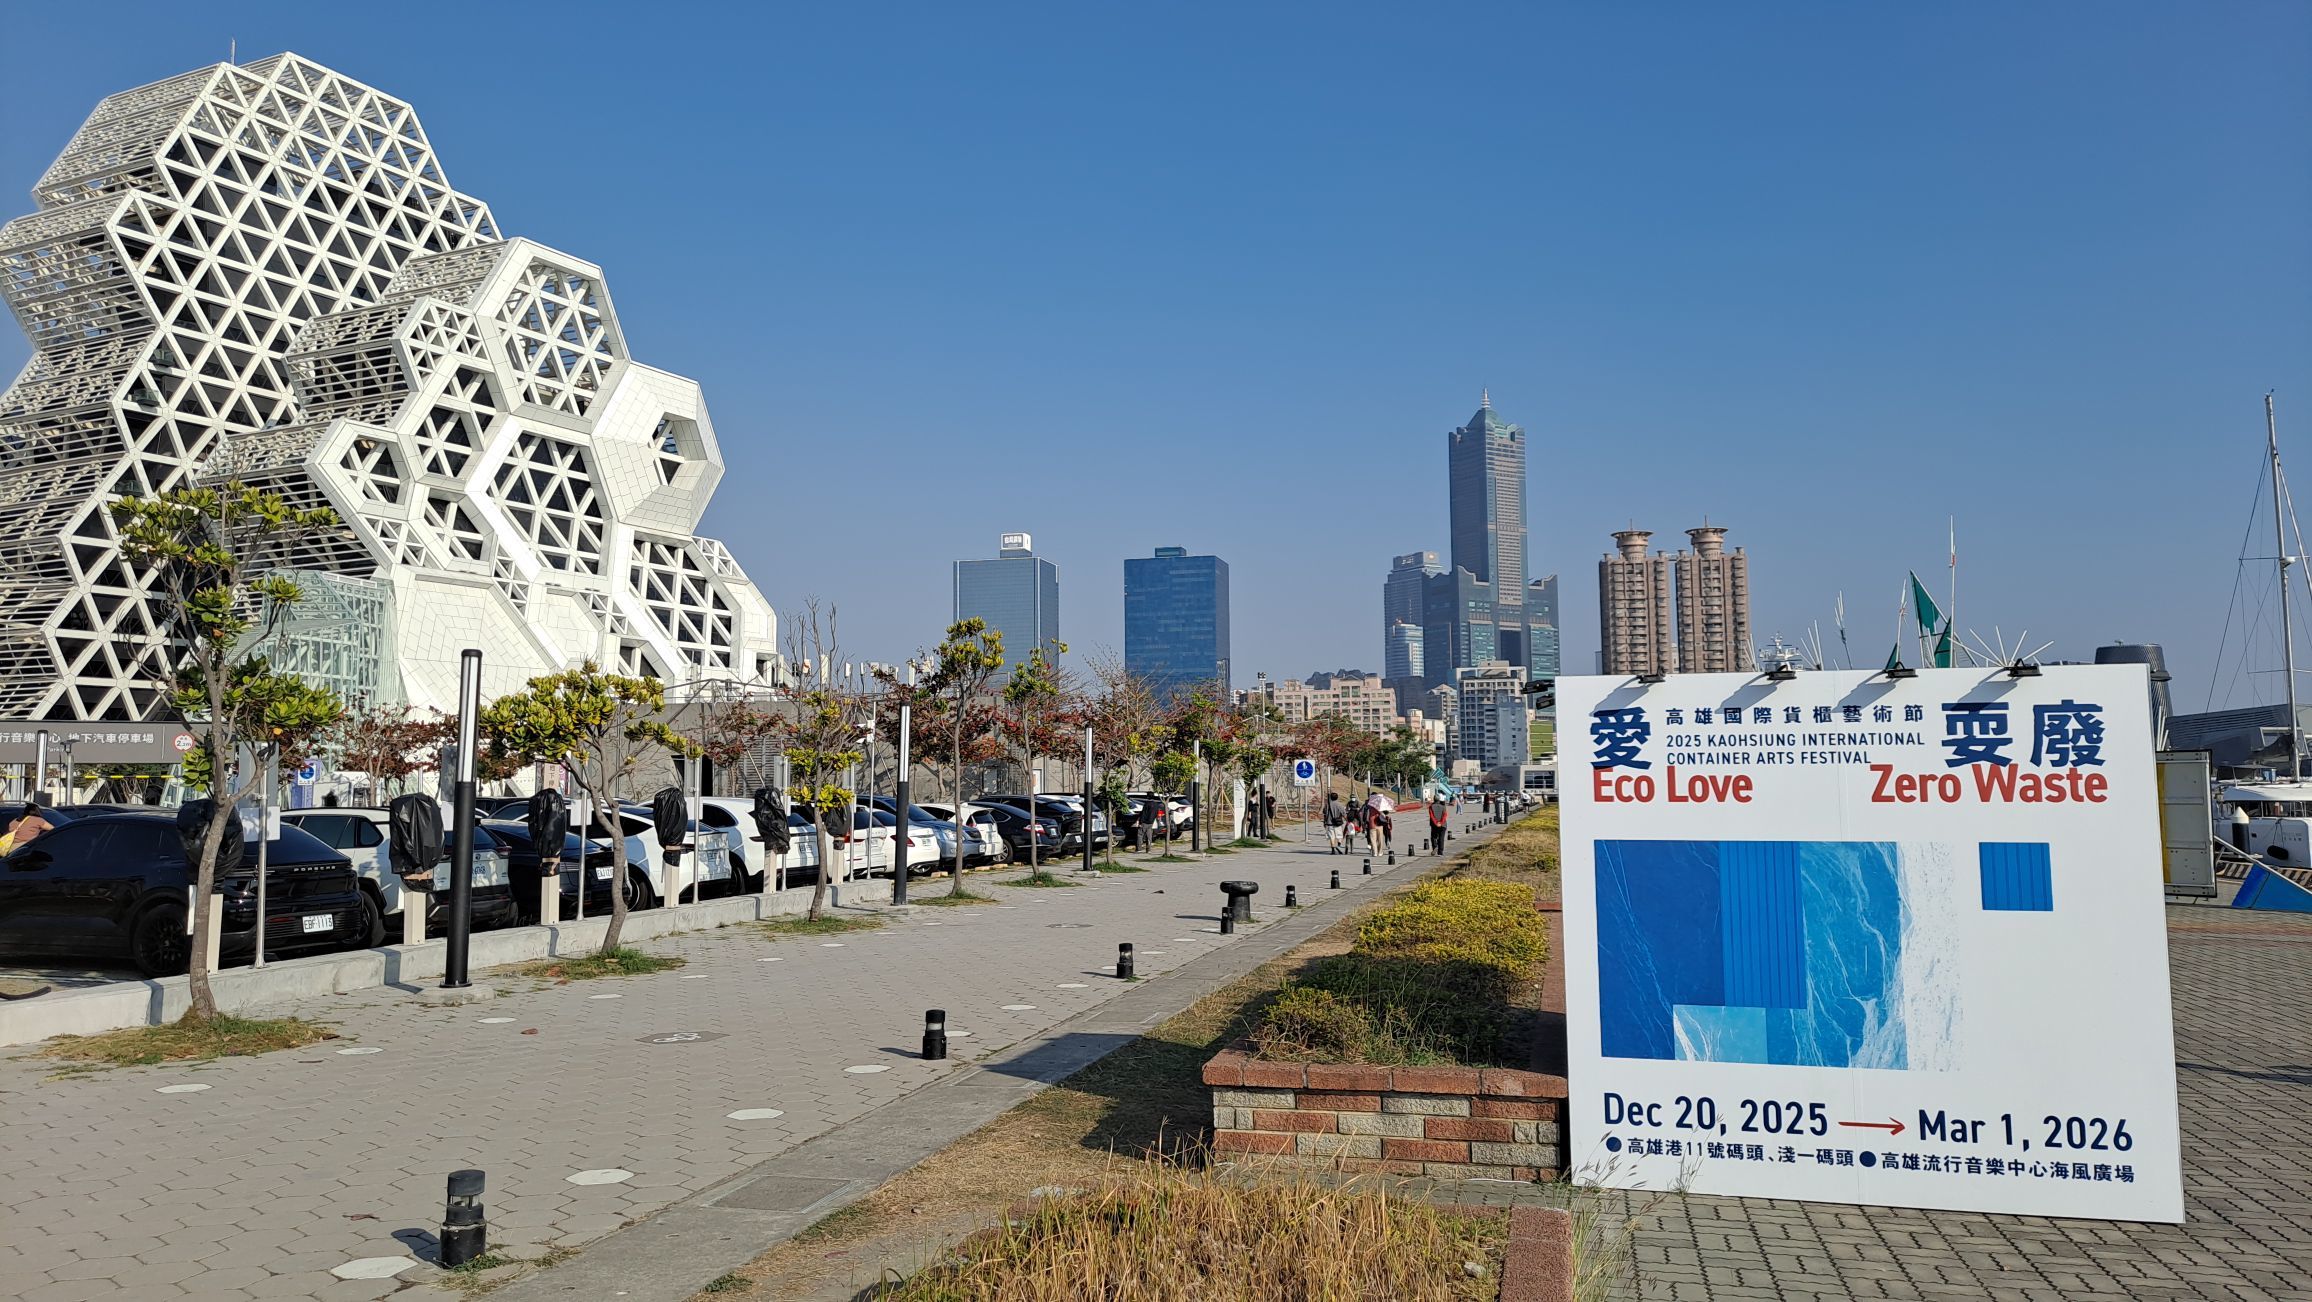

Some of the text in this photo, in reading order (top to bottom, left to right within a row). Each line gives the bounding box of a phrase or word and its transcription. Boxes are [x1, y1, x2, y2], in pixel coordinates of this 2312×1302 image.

[1665, 704, 1924, 725] 高雄國際貨櫃藝術節
[1941, 699, 2107, 769] 耍廢
[0, 732, 155, 745] 行音樂心 地下汽車停車場
[1590, 706, 1652, 770] 愛
[1666, 732, 1926, 748] 2025 KAOHSIUNG INTERNATIONAL
[1667, 751, 1872, 765] CONTAINER ARTS FESTIVAL
[1593, 765, 1754, 803] Eco Love
[1870, 763, 2108, 803] Zero Waste
[1604, 1092, 2133, 1153] Dec 20, 2025 Mar 1, 2026
[1627, 1137, 2136, 1184] 高雄港11號碼頭、淺一碼頭 高雄流行音樂中心海風廣場
